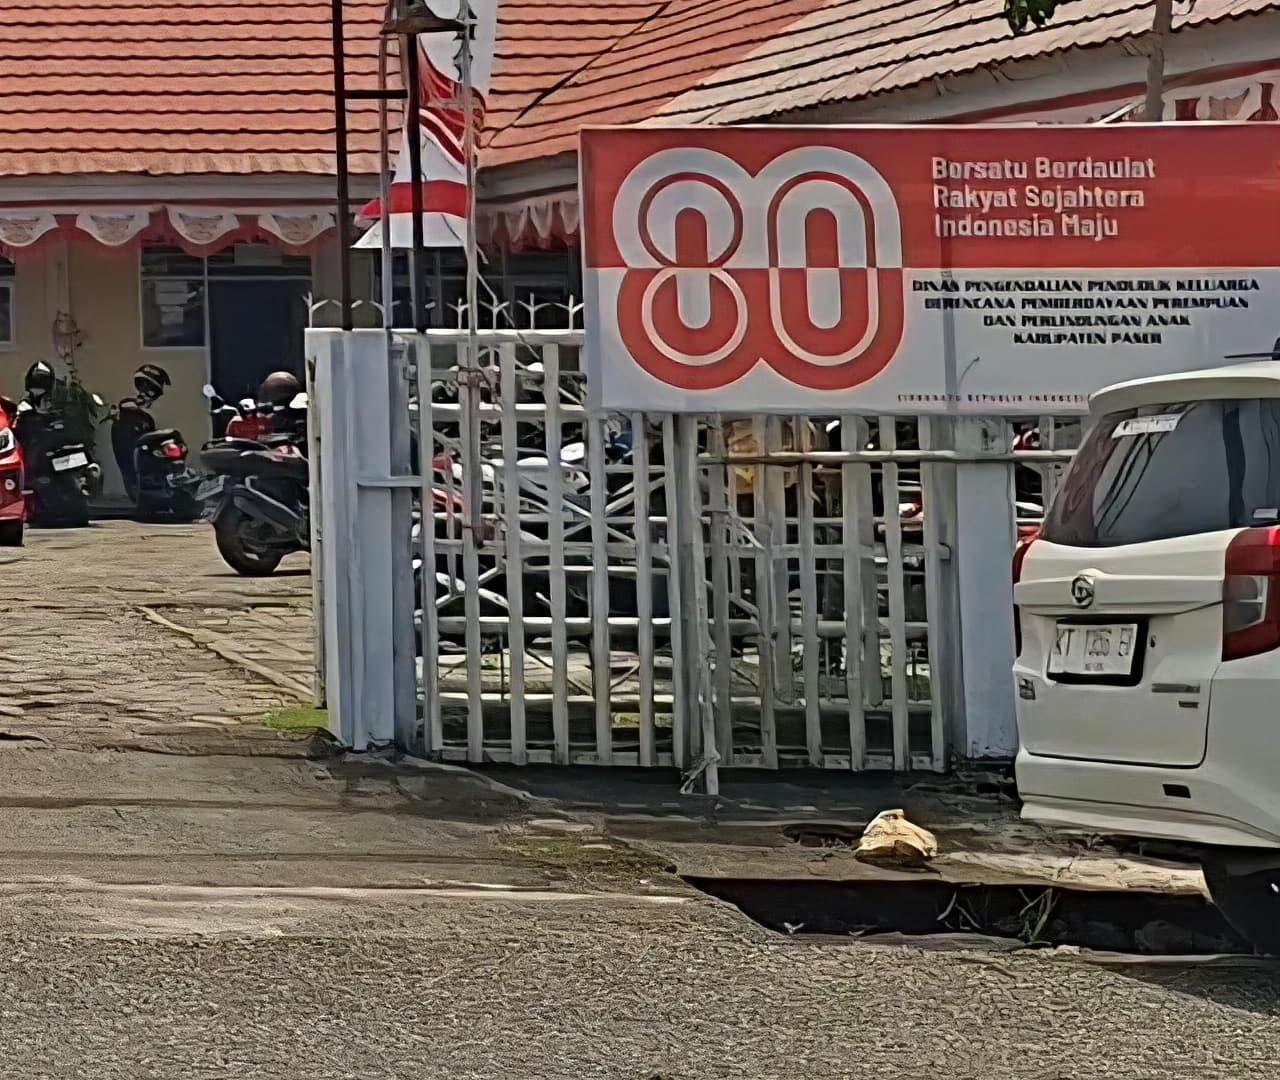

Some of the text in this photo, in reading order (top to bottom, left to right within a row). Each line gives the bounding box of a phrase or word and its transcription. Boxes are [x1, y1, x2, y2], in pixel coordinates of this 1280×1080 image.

[931, 156, 1156, 180] Bersatu Berdaulat
[933, 184, 1146, 213] Rakyat Sejahtera
[934, 213, 1119, 242] Indonesia Maju
[613, 146, 905, 391] 80
[912, 279, 960, 292] DINAS
[1087, 279, 1171, 292] PENDUDUK
[1176, 278, 1260, 291] KELUARGA
[983, 315, 1016, 327] DAN
[1145, 314, 1191, 327] ANAK
[1013, 332, 1106, 344] KABUPATEN
